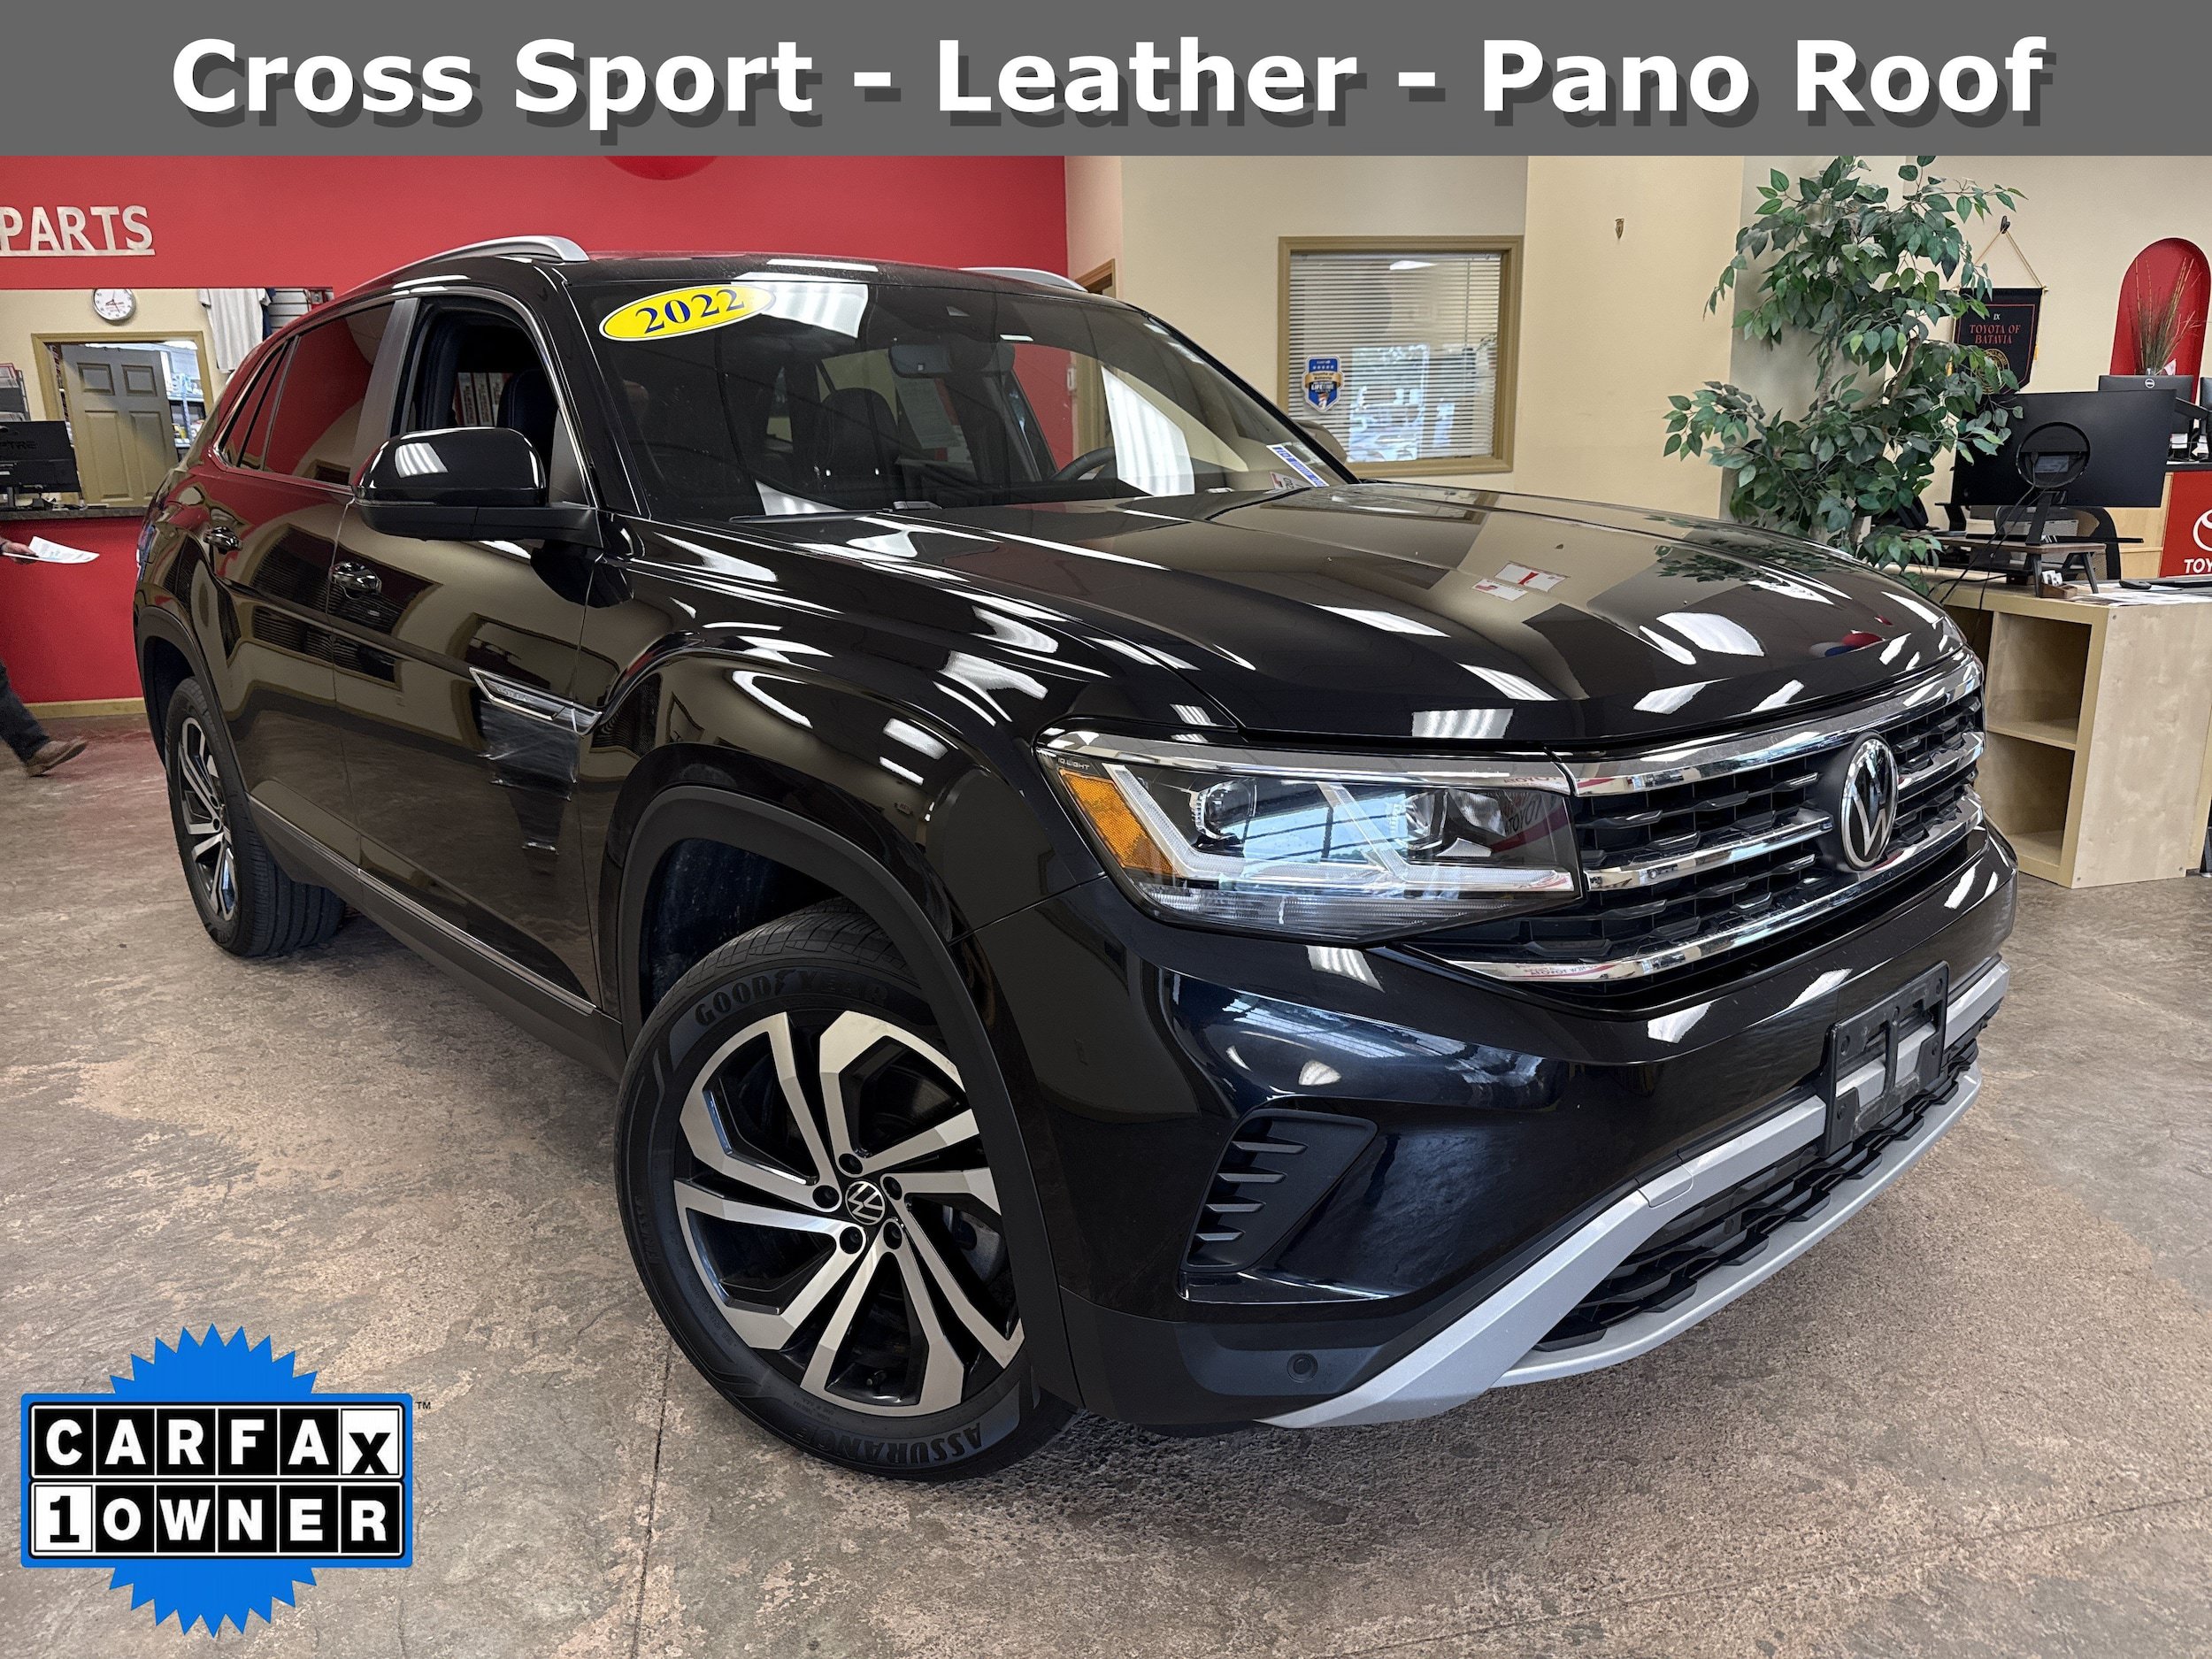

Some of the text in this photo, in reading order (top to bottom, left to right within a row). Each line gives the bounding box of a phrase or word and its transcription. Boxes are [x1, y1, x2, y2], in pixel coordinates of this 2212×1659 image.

[0, 205, 154, 251] PARTS
[635, 288, 745, 334] 2022
[1970, 324, 2021, 334] TOYOTA OF
[1974, 334, 2013, 344] BATAVIA
[795, 1421, 982, 1465] ASSURANCE
